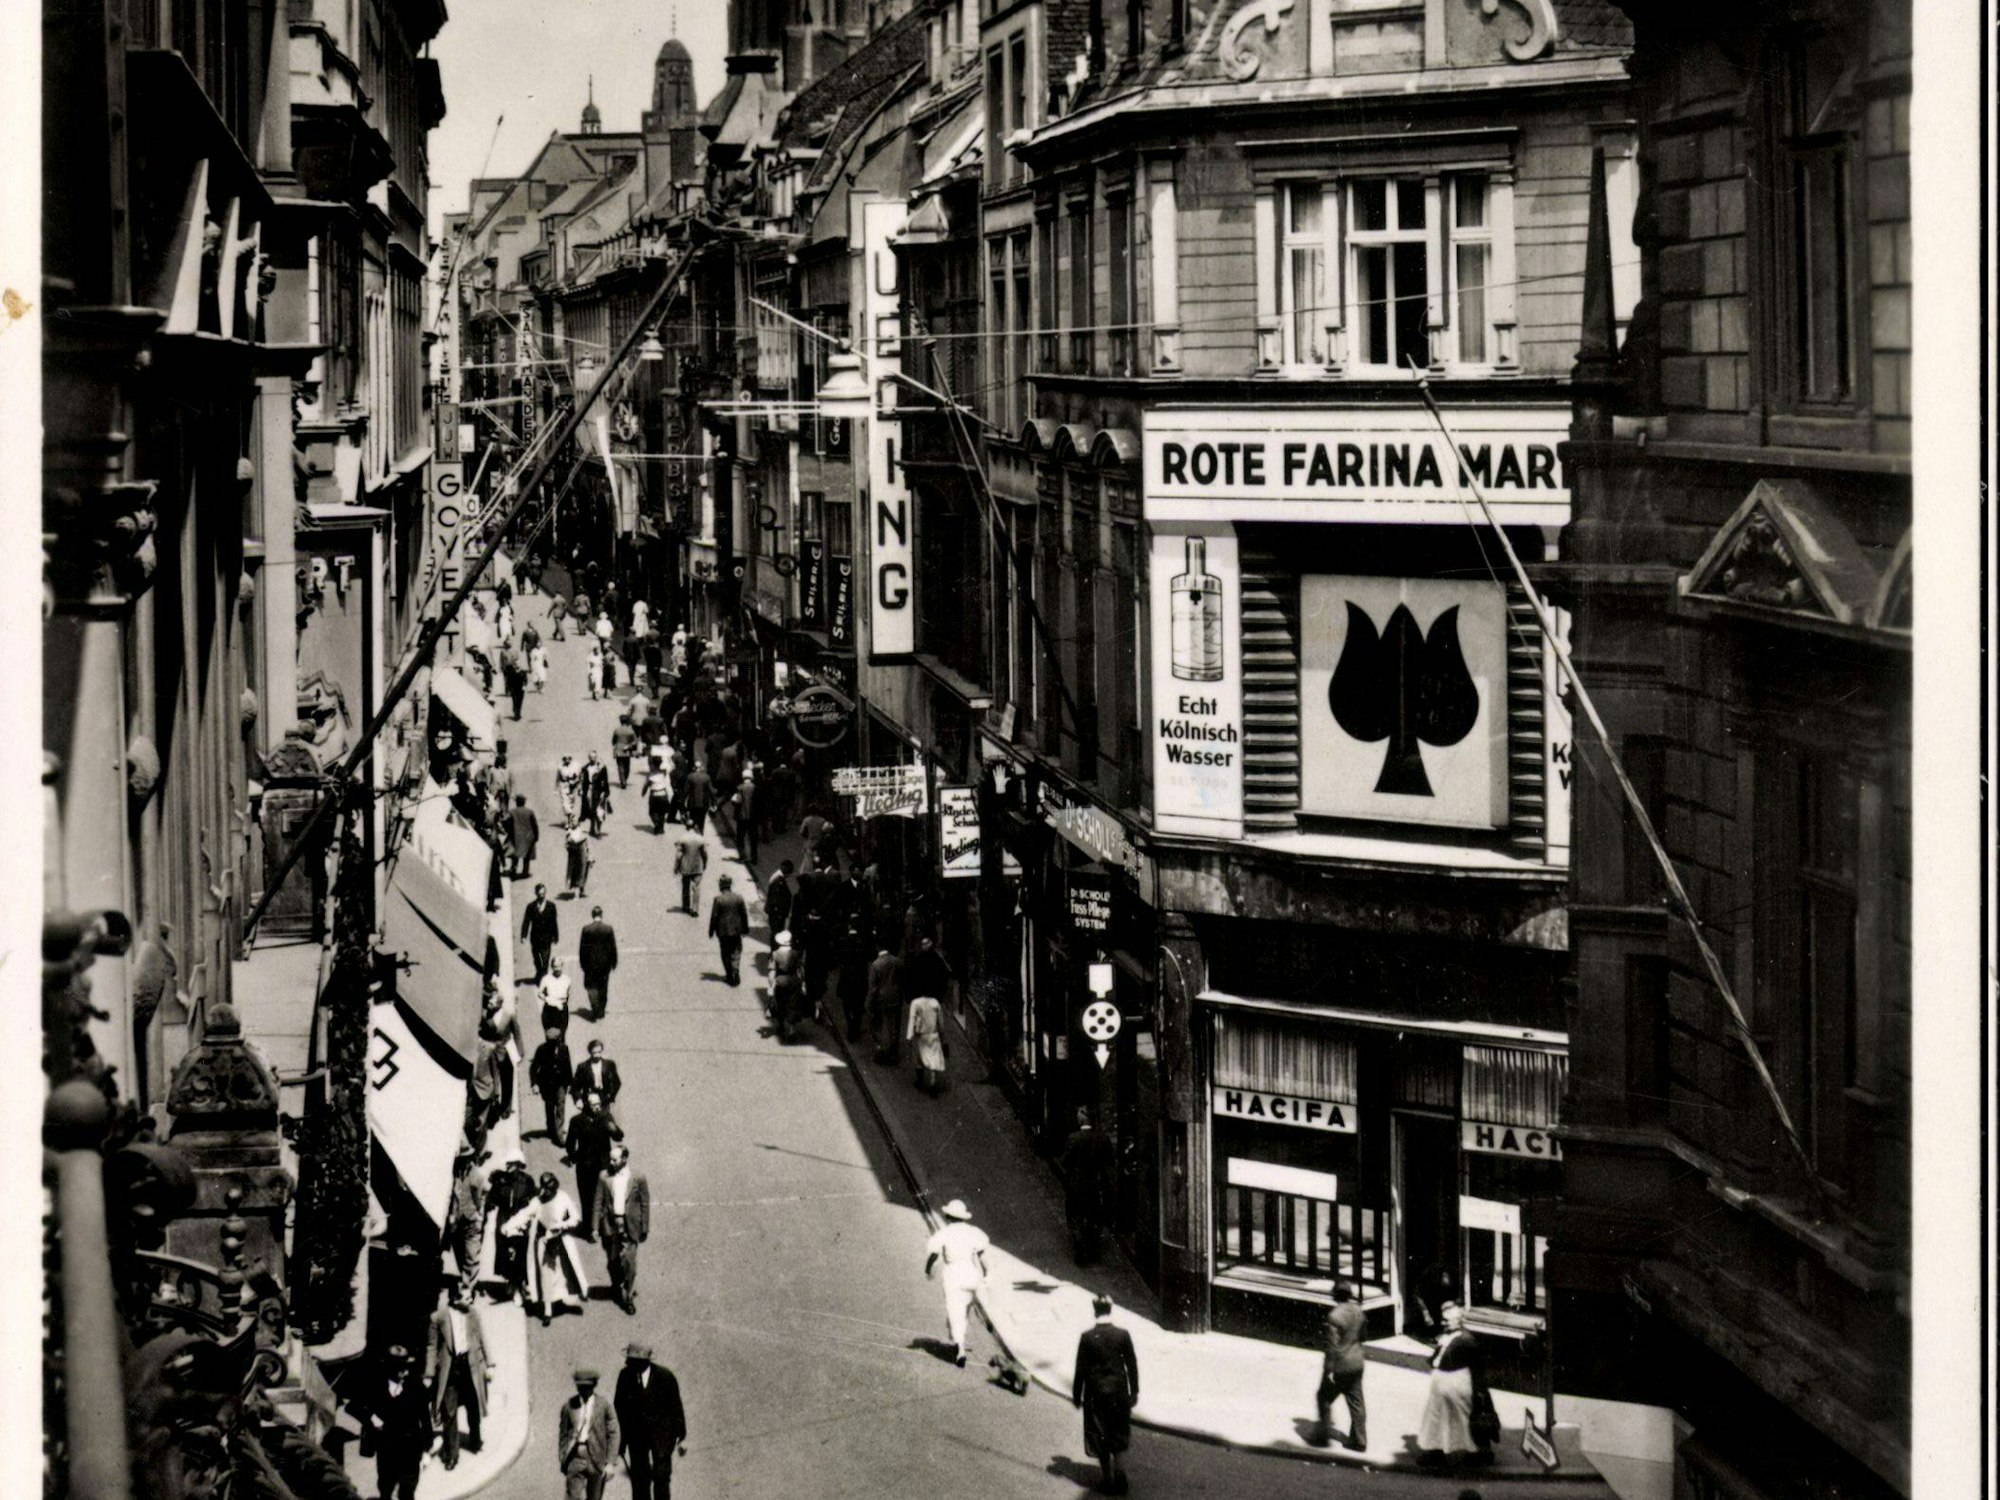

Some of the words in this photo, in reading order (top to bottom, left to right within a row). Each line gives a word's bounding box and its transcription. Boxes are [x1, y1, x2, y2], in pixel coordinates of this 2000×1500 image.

[1161, 442, 1266, 486] ROTE
[1283, 443, 1443, 489] FARINA
[1178, 694, 1218, 716] Echt
[1160, 718, 1238, 744] Kölnisch
[1166, 743, 1234, 768] Wasser
[1075, 917, 1106, 930] SYSTEM
[1225, 1091, 1346, 1129] HACIFA
